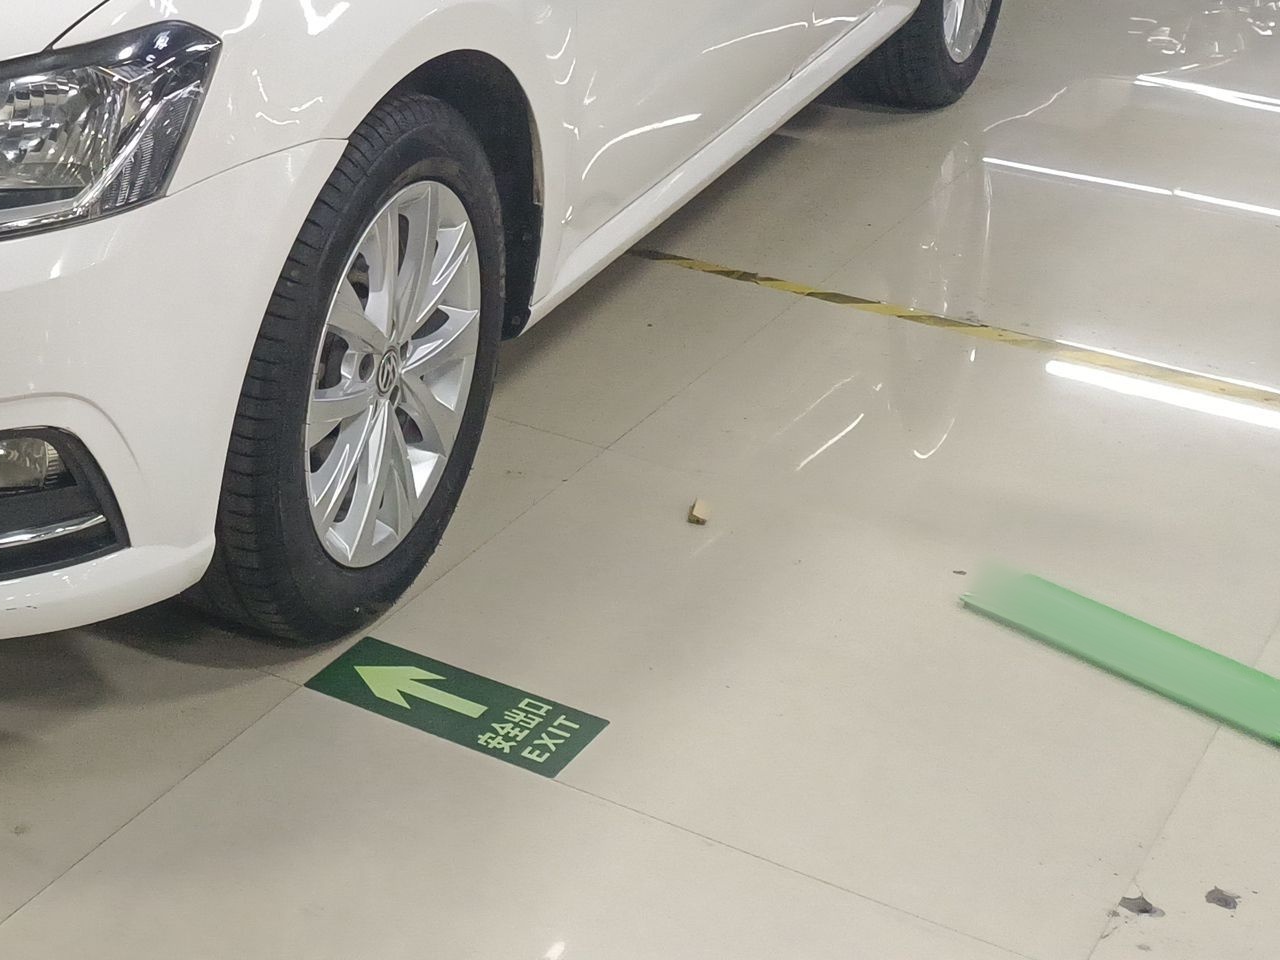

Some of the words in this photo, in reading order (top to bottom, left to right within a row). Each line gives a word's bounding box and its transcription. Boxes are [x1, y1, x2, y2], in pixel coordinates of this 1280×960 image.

[477, 697, 553, 754] 安全出口
[521, 714, 580, 764] EXIT
